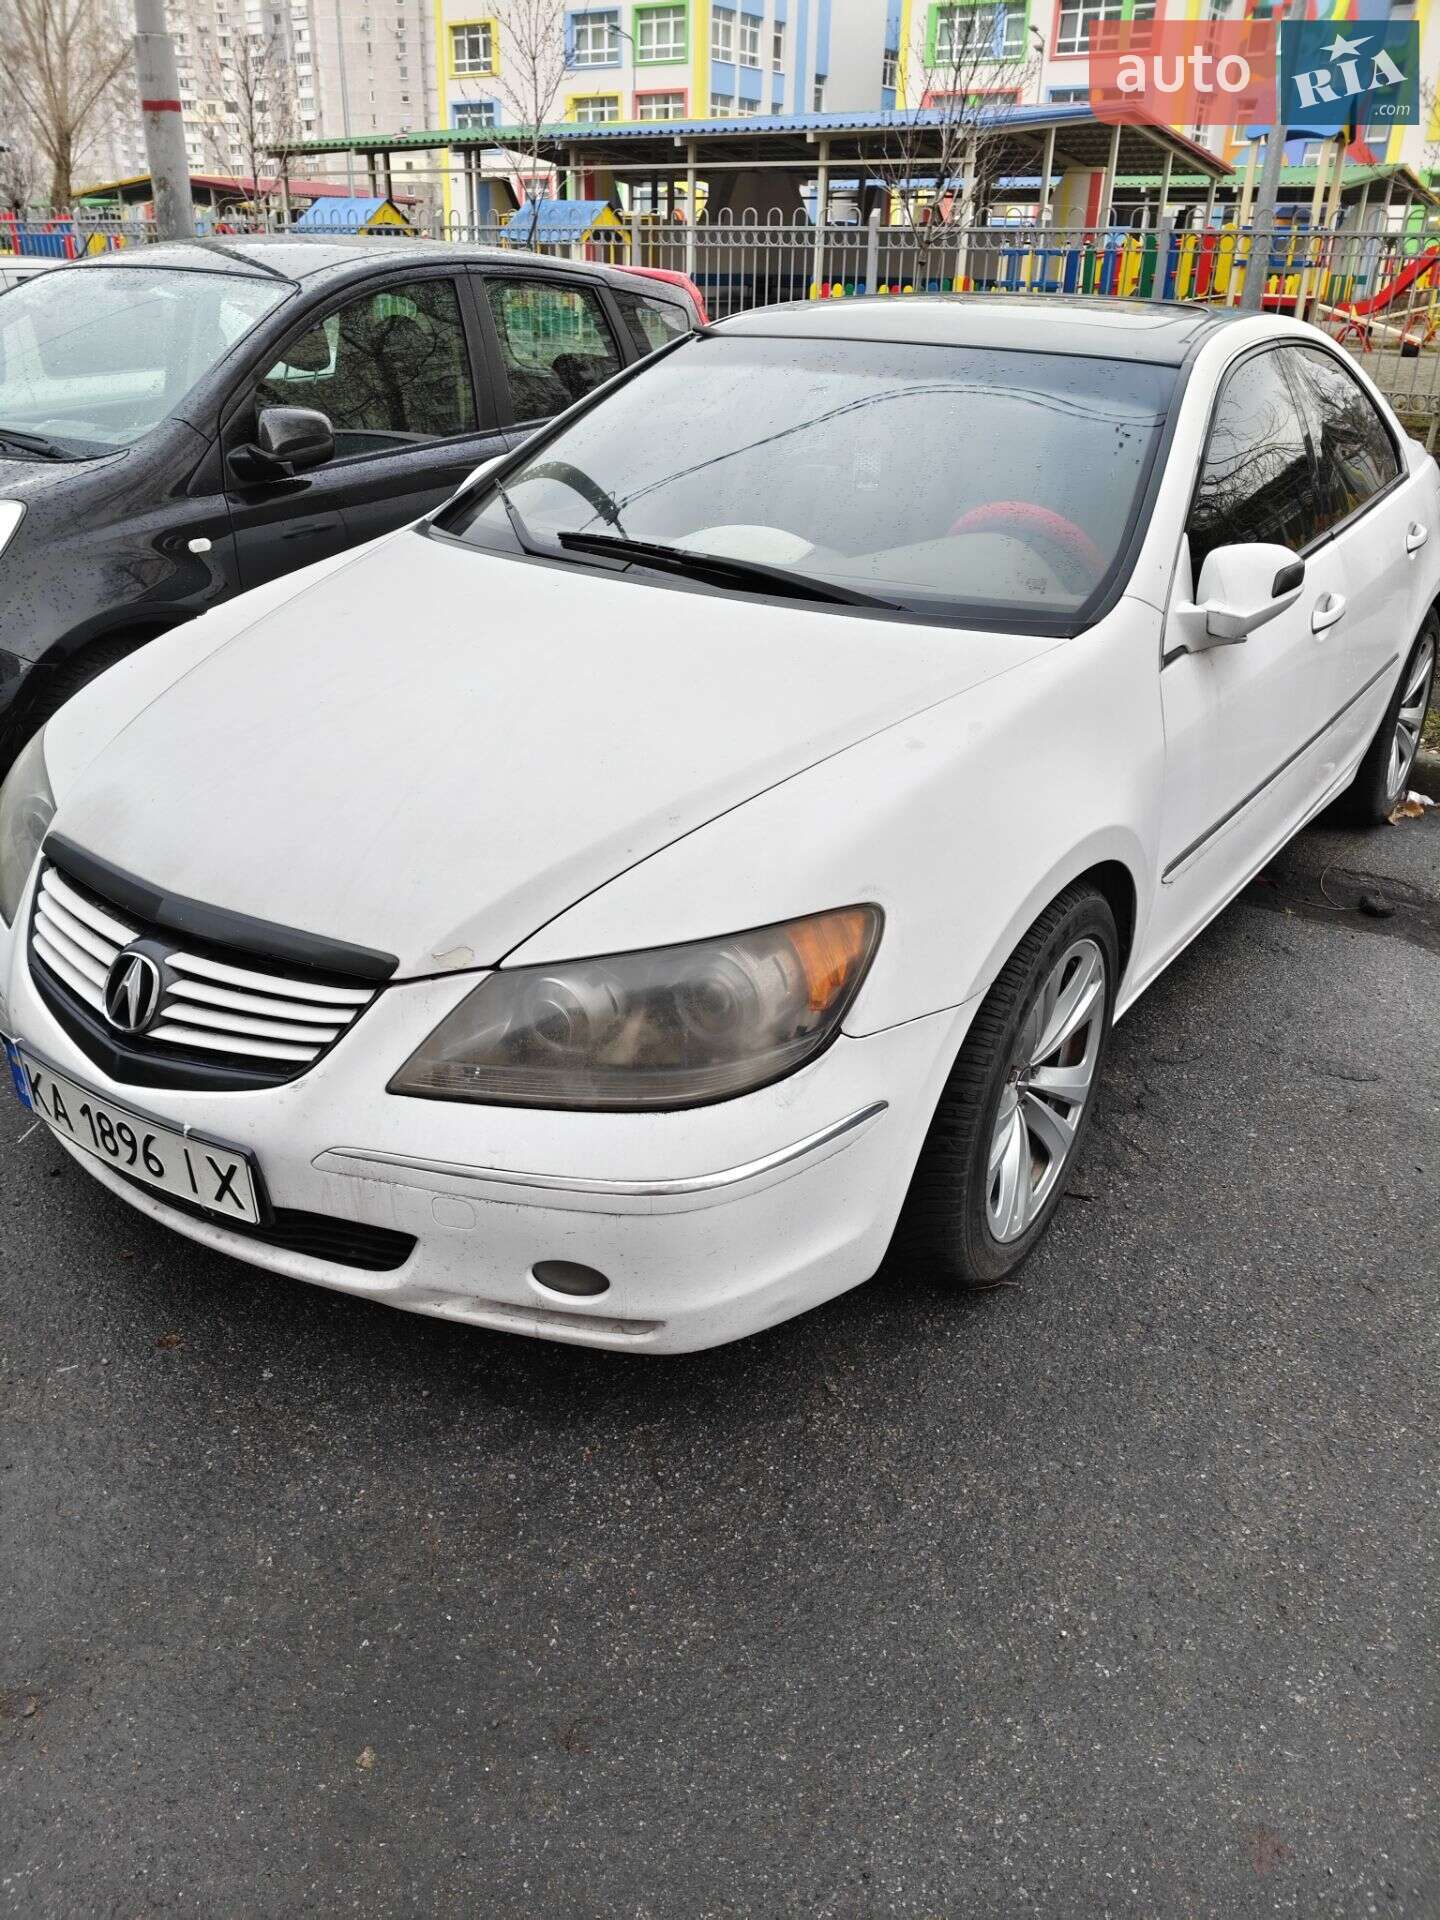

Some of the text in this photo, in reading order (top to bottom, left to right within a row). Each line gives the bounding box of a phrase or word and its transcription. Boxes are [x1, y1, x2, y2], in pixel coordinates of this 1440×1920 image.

[24, 1063, 245, 1210] KA 1896 IX
